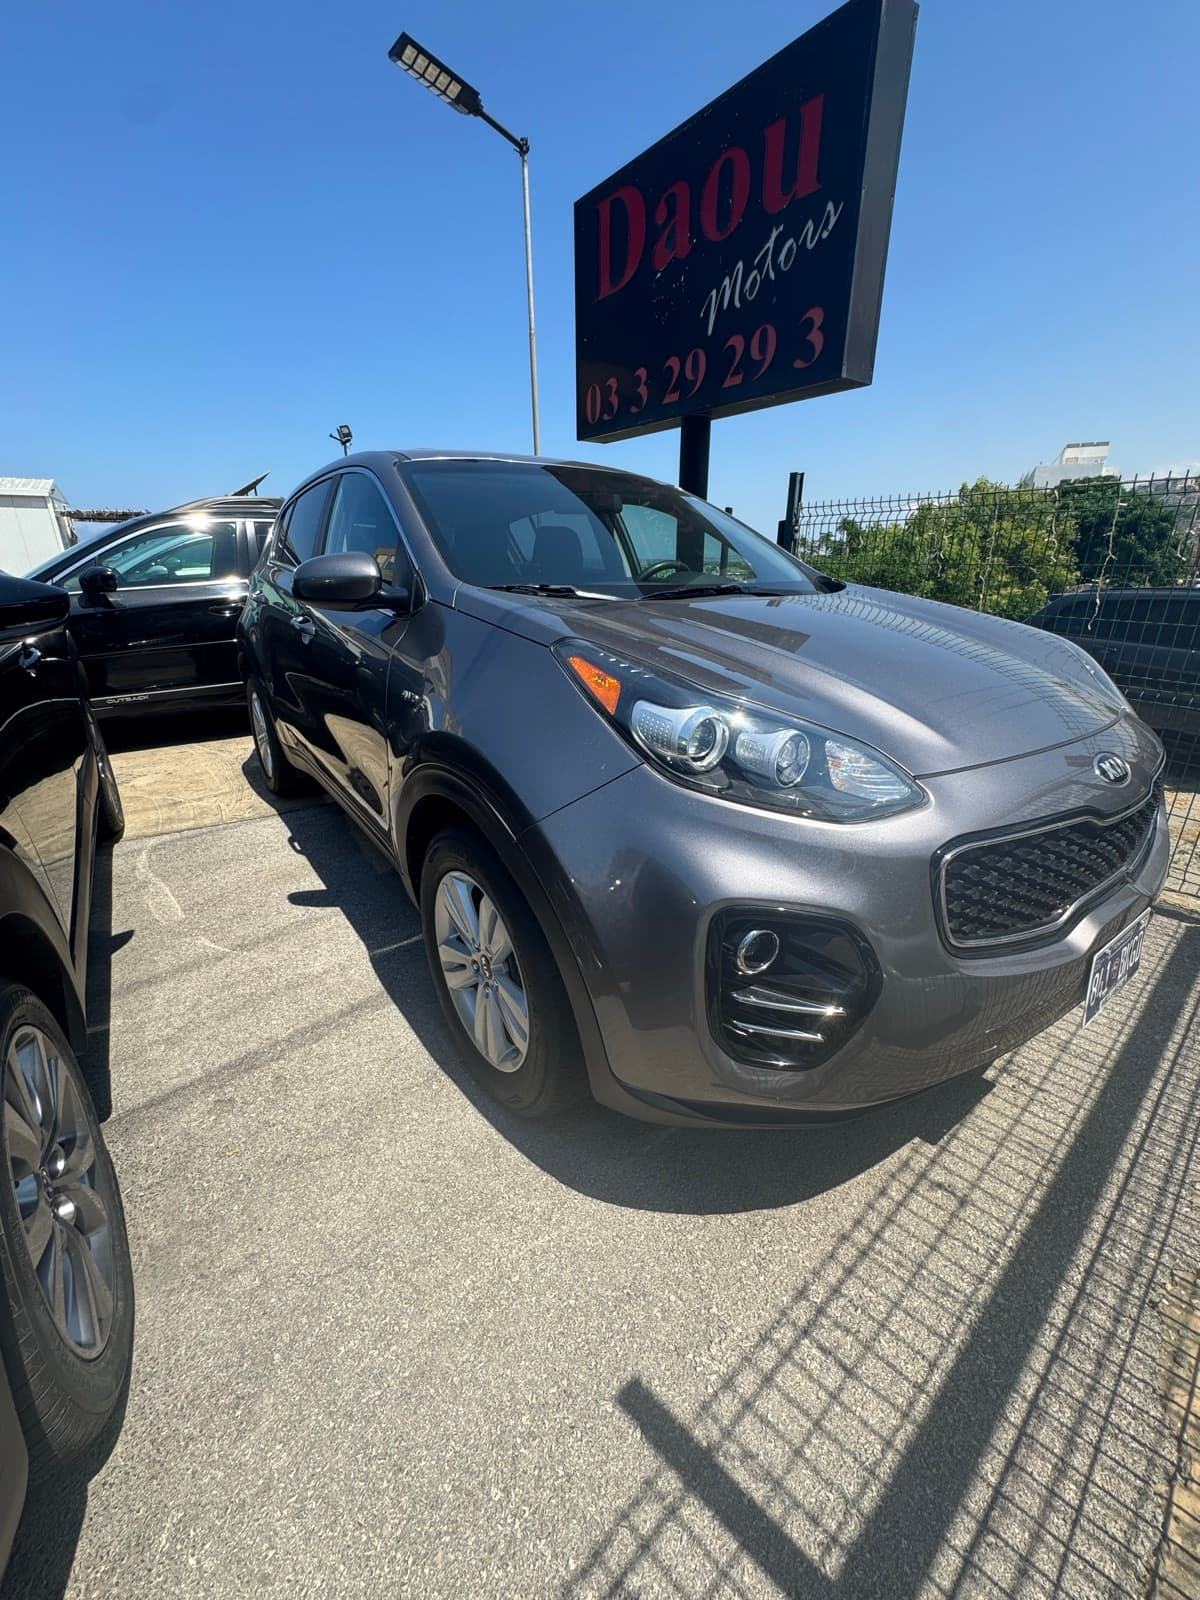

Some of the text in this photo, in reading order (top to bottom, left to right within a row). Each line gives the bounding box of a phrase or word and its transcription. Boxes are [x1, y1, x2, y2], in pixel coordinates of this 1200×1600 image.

[596, 94, 825, 300] Daou
[700, 201, 844, 336] Motors
[586, 306, 825, 425] 03 3 29 29 3
